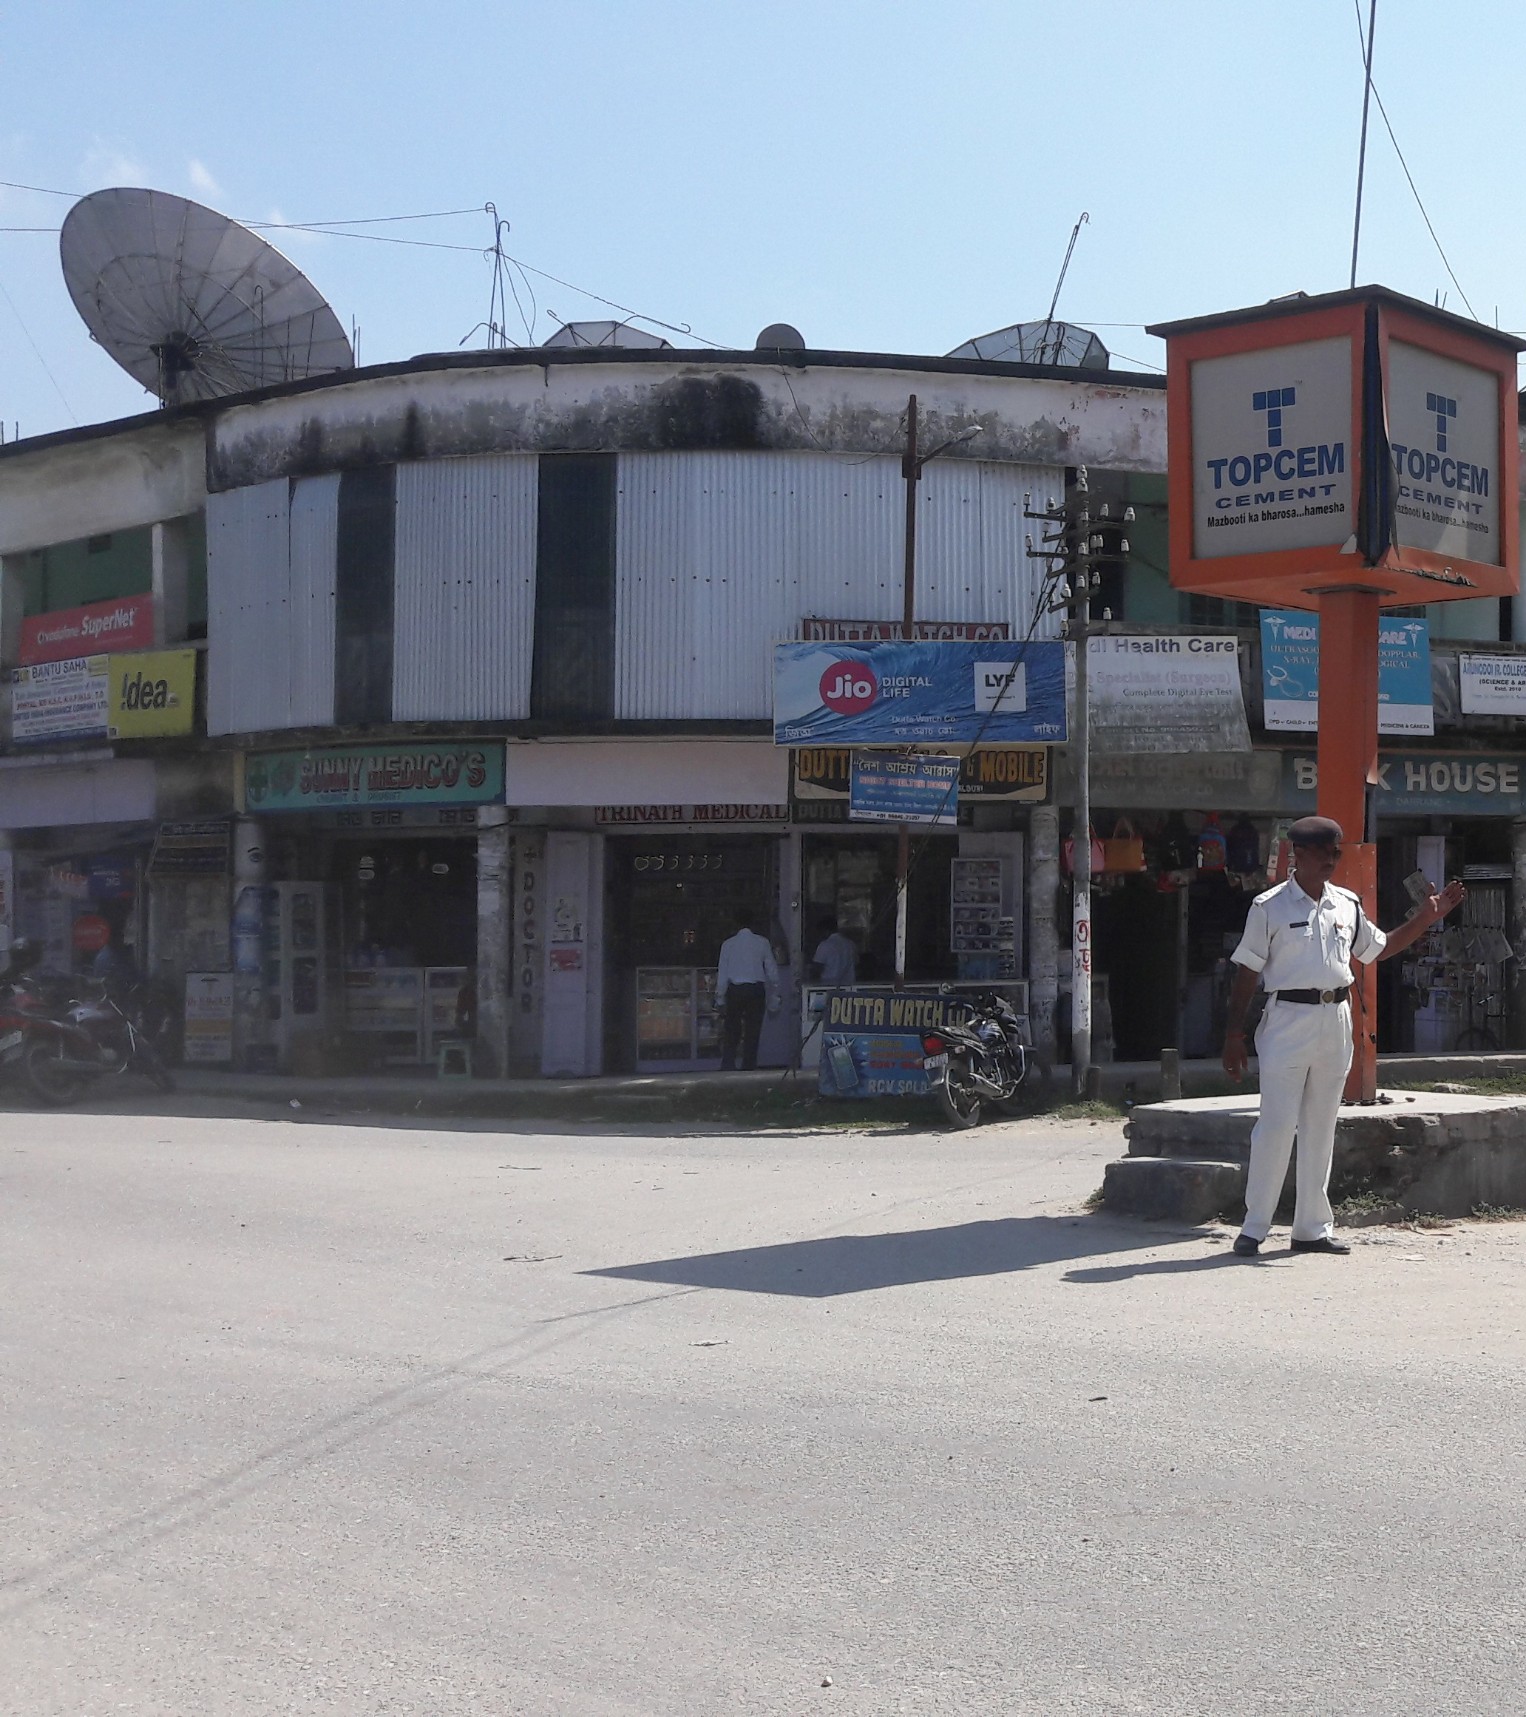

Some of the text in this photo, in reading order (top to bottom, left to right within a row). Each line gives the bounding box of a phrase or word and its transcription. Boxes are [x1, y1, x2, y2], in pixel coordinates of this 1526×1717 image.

[1207, 442, 1345, 490] TOPCEM
[1390, 443, 1489, 497] TOPCEM
[1216, 484, 1337, 509] CEMENT
[1399, 486, 1484, 515] CEMENT
[1207, 514, 1246, 528] Mazbooti
[1248, 513, 1260, 524] ka
[1422, 509, 1431, 520] ka
[81, 609, 134, 638] SuperNet
[1284, 626, 1317, 640] MEDI
[1115, 639, 1181, 652] Health
[1188, 639, 1235, 652] Care
[1378, 630, 1407, 645] ARE
[32, 662, 61, 679] BANTU
[62, 659, 88, 673] SAHA
[827, 674, 872, 699] Jio
[882, 677, 933, 687] DIGITAL
[985, 674, 1016, 687] LYF
[882, 688, 911, 699] LIFE
[1123, 688, 1233, 698] Complete Digital Eye Test
[300, 751, 487, 794] SUNNY MEDICO'S
[800, 749, 850, 780] DUTT
[979, 750, 1044, 783] MOBILE
[1404, 760, 1520, 793] HOUSE
[597, 804, 789, 821] TRINATH MEDICAL
[830, 997, 885, 1026] DUTTA
[890, 998, 945, 1027] WATCH
